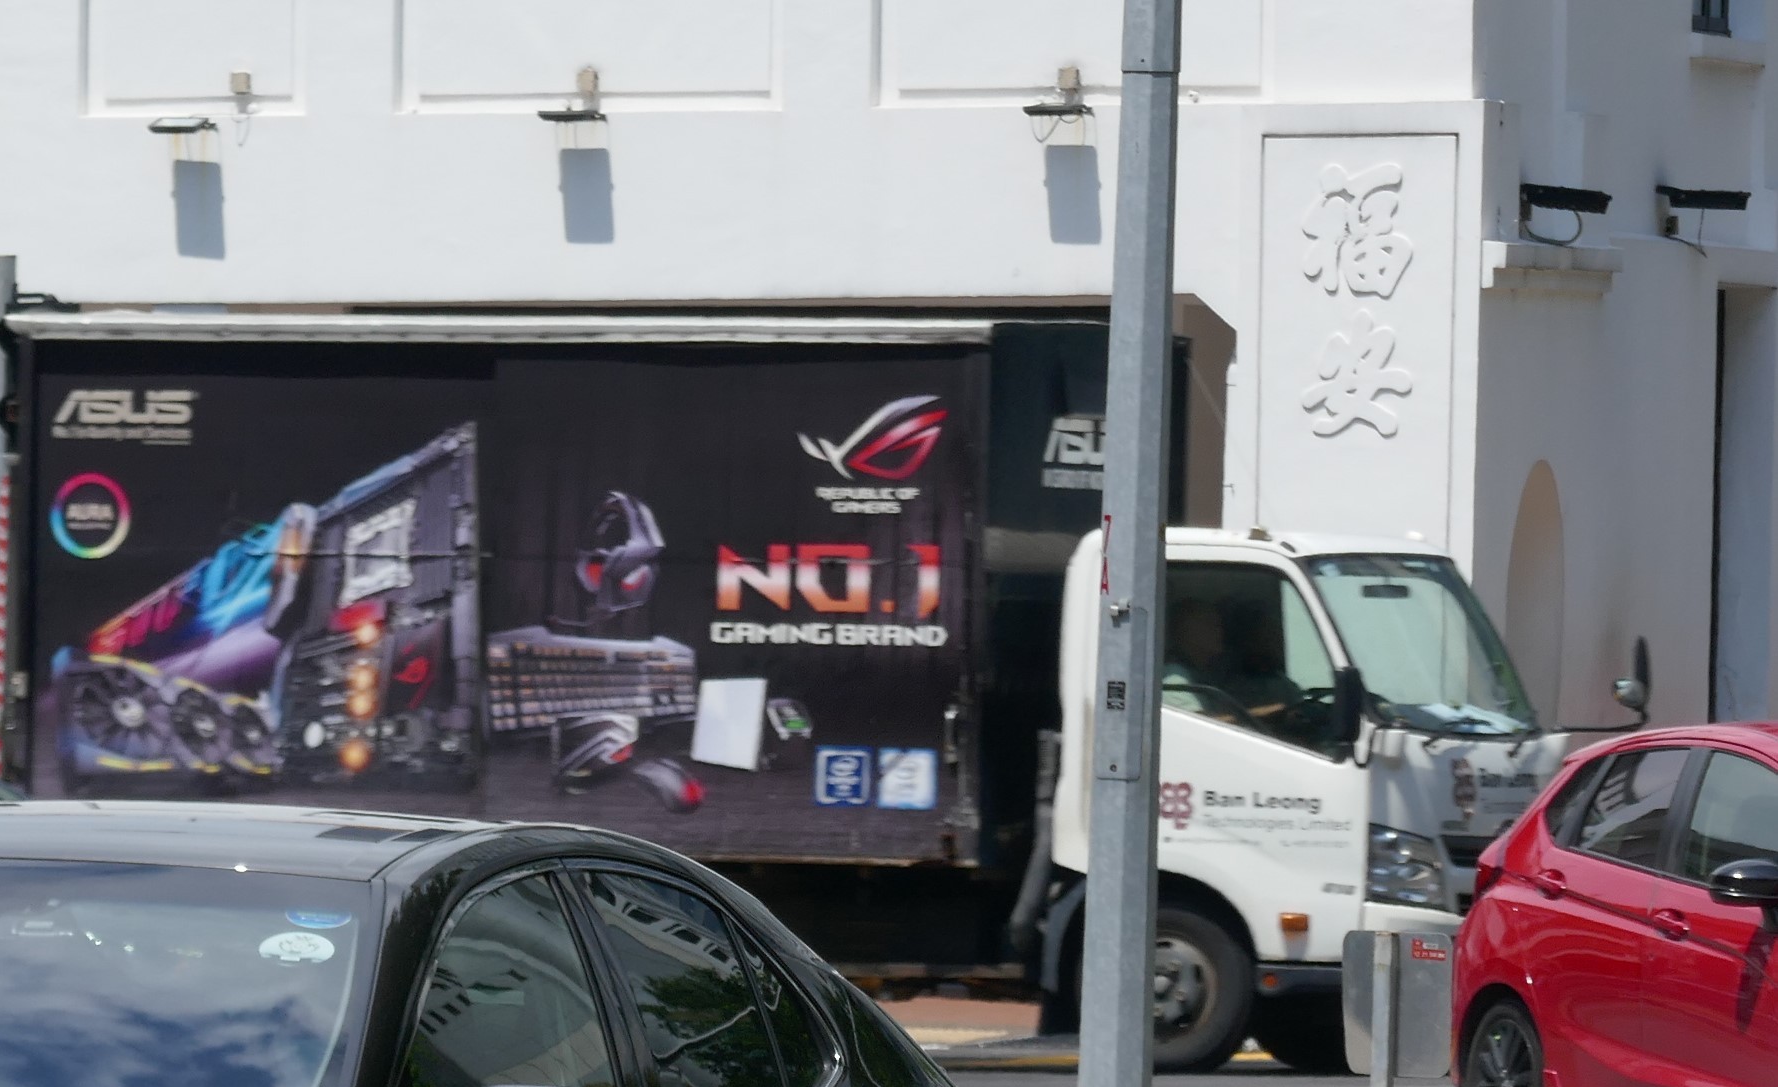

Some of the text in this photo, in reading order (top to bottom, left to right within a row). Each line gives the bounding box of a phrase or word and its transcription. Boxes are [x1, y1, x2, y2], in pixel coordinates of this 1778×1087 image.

[53, 389, 196, 424] ASUS
[1044, 415, 1105, 466] ASU
[831, 501, 901, 514] GAMERS
[716, 543, 941, 618] NO.1
[709, 622, 949, 647] GAMING BRAND
[1203, 790, 1321, 815] Ban Leong
